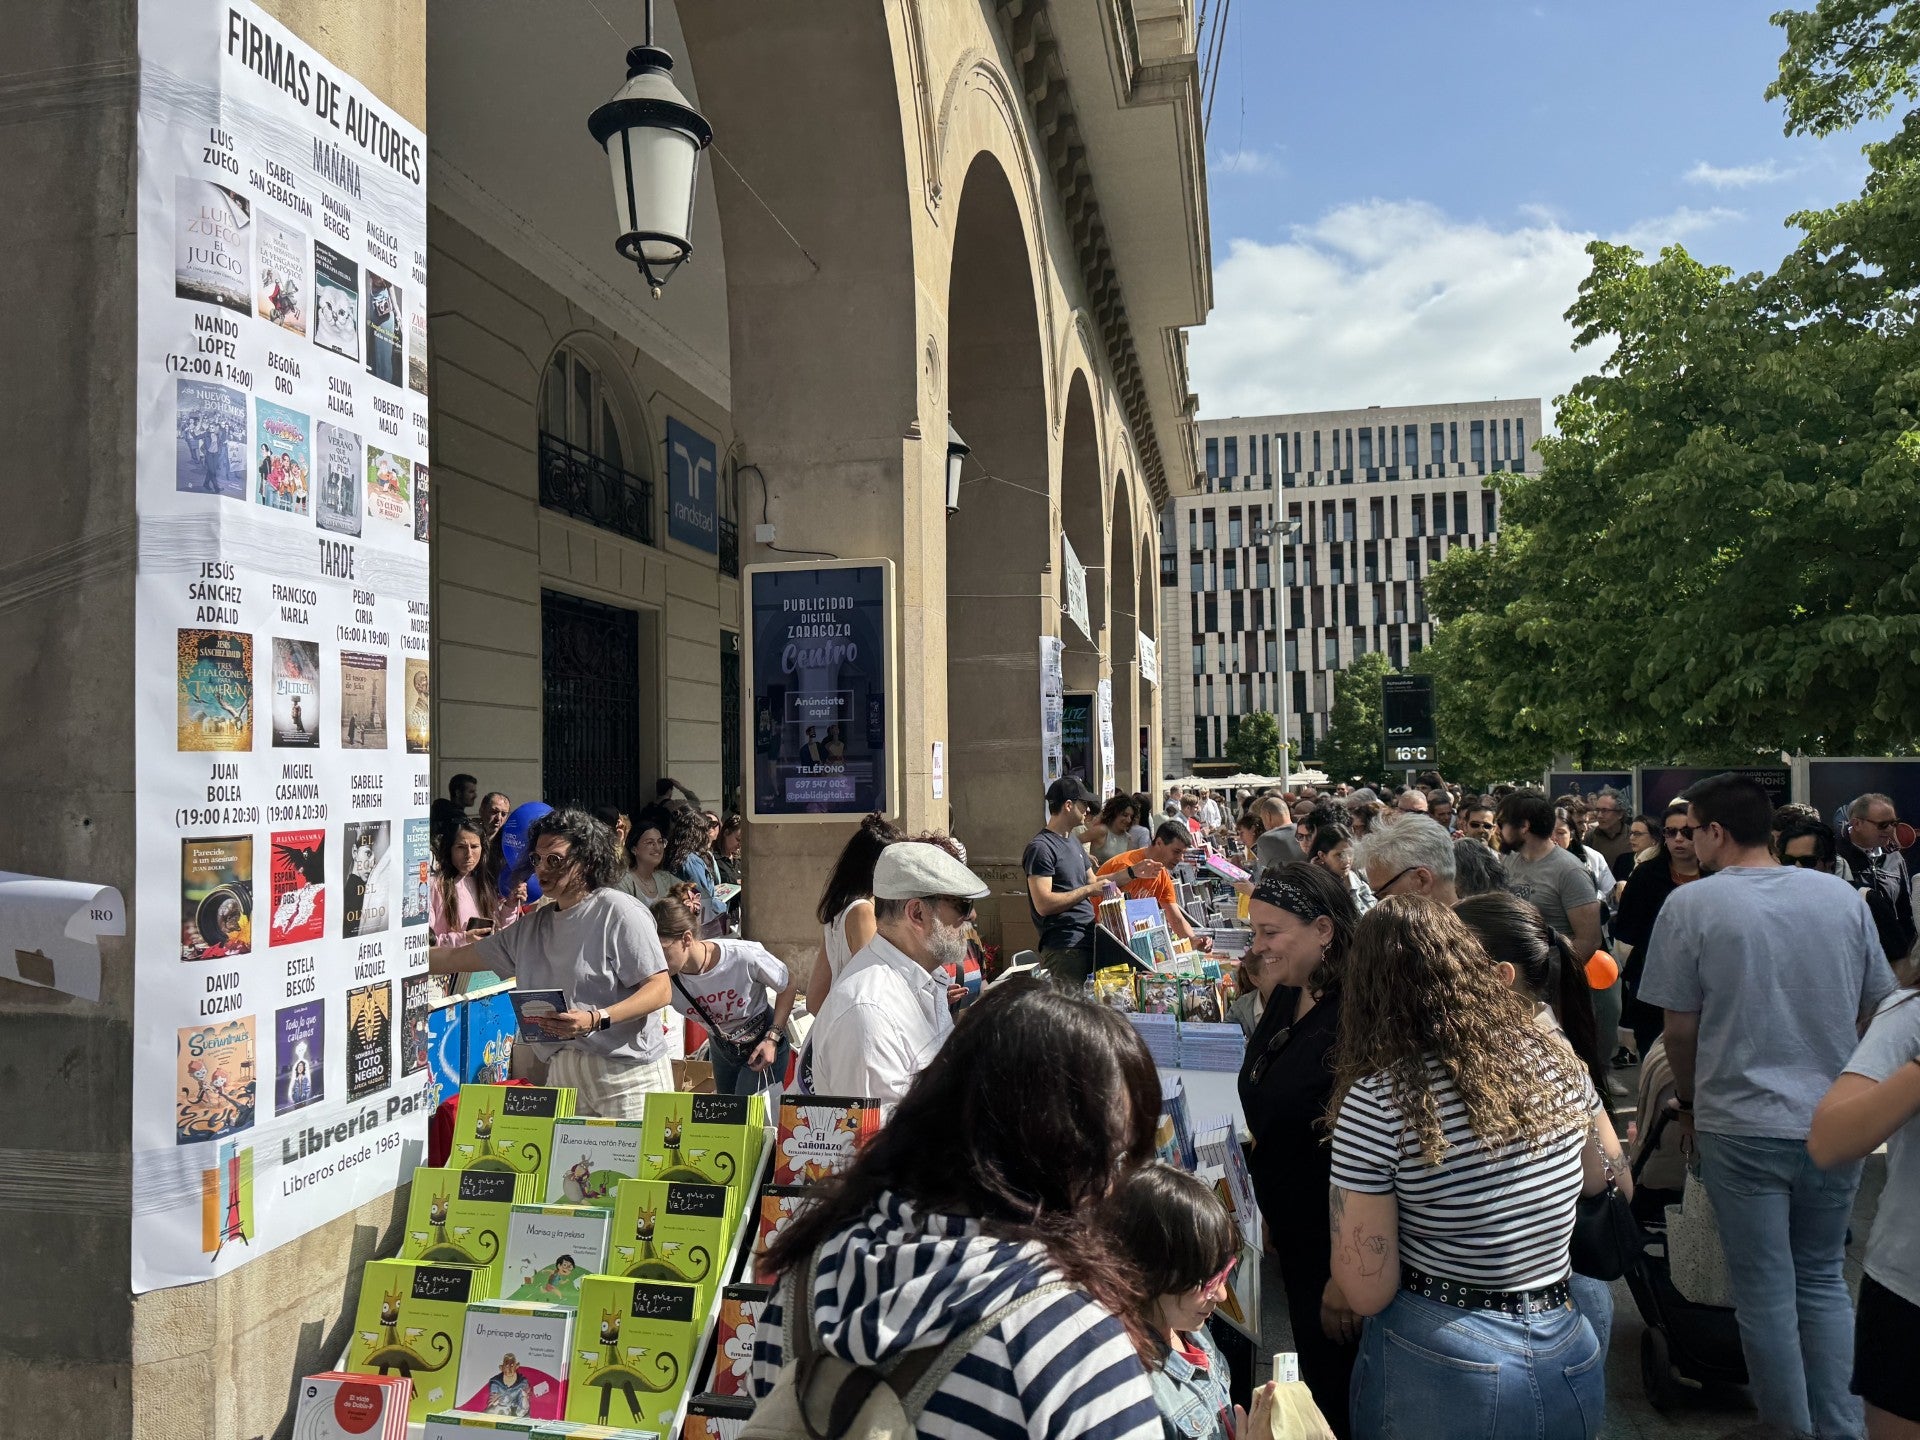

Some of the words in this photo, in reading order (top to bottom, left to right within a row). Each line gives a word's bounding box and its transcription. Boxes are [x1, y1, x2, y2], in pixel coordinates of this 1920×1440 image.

[228, 7, 311, 106] FIRMAS
[315, 71, 341, 129] DE
[345, 95, 420, 185] AUTORES
[210, 128, 234, 152] LUIS
[203, 147, 239, 175] ZUECO
[313, 137, 361, 200] MAÑANA
[266, 159, 295, 189] ISABEL
[249, 169, 265, 193] SAN
[266, 179, 312, 218] SEBASTIÁN
[321, 192, 351, 223] JOAQUÍN
[201, 205, 234, 228] LUIS
[187, 219, 240, 247] ZUECO
[323, 212, 350, 240] BERGES
[366, 220, 398, 252] ANGÉLICA
[214, 240, 225, 252] EL
[367, 239, 397, 268] MORALES
[187, 246, 242, 275] JUICIO
[194, 313, 239, 338] NANDO
[199, 335, 236, 360] LÓPEZ
[165, 353, 211, 375] (12:00
[214, 361, 223, 377] A
[226, 364, 253, 391] 14:00)
[268, 351, 301, 379] BEGOÑA
[275, 376, 293, 395] ORO
[328, 376, 352, 398] SILVIA
[196, 390, 231, 404] NUEVOS
[327, 395, 354, 418] ALIAGA
[373, 396, 404, 421] ROBERTO
[379, 417, 398, 436] MALO
[328, 435, 354, 452] VERANO
[329, 454, 352, 466] NUNCA
[674, 501, 713, 533] randstad
[318, 538, 355, 580] TARDE
[199, 561, 235, 581] JESÚS
[188, 581, 242, 604] SÁNCHEZ
[272, 583, 317, 606] FRANCISCO
[353, 588, 375, 607] PEDRO
[783, 597, 854, 612] PUBLICIDAD
[196, 606, 239, 625] ADALID
[281, 606, 309, 625] NARLA
[355, 608, 374, 626] CIRIA
[801, 612, 836, 623] DIGITAL
[336, 624, 361, 642] (16:00
[361, 630, 367, 642] A
[368, 630, 390, 648] 19:00)
[787, 623, 851, 639] ZARAGOZA
[400, 635, 420, 651] (16:00
[420, 638, 426, 651] A
[733, 635, 739, 651] S
[199, 648, 225, 658] SÁNCHEZ
[781, 640, 858, 674] Centro
[198, 668, 244, 679] HALCONES
[216, 662, 232, 670] TRES
[795, 696, 845, 706] Anúnciate
[809, 707, 831, 718] aquí
[1395, 747, 1427, 760] 16°C
[210, 763, 239, 780] JUAN
[282, 763, 313, 780] MIGUEL
[796, 763, 845, 774] TELÉFONO
[351, 775, 383, 790] ISABELLE
[812, 780, 827, 788] 547
[207, 786, 242, 802] BOLEA
[275, 784, 319, 801] CASANOVA
[351, 793, 382, 808] PARRISH
[413, 792, 425, 805] DEL
[175, 808, 220, 828] (19:00
[222, 808, 230, 824] A
[232, 806, 260, 824] 20:30)
[266, 805, 293, 825] (19:00
[294, 804, 301, 820] A
[302, 803, 328, 822] 20:30)
[361, 835, 374, 846] EL
[193, 849, 225, 857] Parecido
[211, 855, 239, 864] asesinato
[191, 865, 207, 873] JUAN
[274, 882, 298, 894] PARTIDA
[357, 884, 377, 896] DEL
[274, 895, 282, 906] EN
[282, 894, 295, 905] DOS
[346, 906, 386, 922] OLVIDO
[357, 941, 383, 961] ÁFRICA
[287, 956, 315, 977] ESTELA
[354, 960, 386, 981] VÁZQUEZ
[206, 972, 240, 993] DAVID
[286, 974, 316, 998] BESCÓS
[200, 993, 242, 1016] LOZANO
[285, 1019, 299, 1030] Todo
[299, 1016, 305, 1028] lo
[305, 1015, 317, 1029] que
[287, 1026, 314, 1043] callamos
[354, 1049, 374, 1060] SOMBRA
[358, 1055, 381, 1071] LOTO
[354, 1065, 384, 1084] NEGRO
[505, 1102, 537, 1112] Valero
[521, 1095, 548, 1103] quiero
[710, 1101, 738, 1111] quiero
[692, 1109, 728, 1121] Valero
[282, 1107, 379, 1165] Librería
[816, 1132, 825, 1141] El
[797, 1141, 842, 1151] cañonazo
[283, 1160, 335, 1197] Libreros
[337, 1146, 371, 1172] desde
[375, 1132, 400, 1155] 1963
[461, 1186, 494, 1196] Valero
[478, 1178, 505, 1187] quiero
[686, 1192, 715, 1201] quiero
[669, 1200, 704, 1211] Valero
[526, 1223, 551, 1236] Marisa
[551, 1231, 556, 1239] y
[556, 1229, 563, 1237] la
[563, 1230, 585, 1239] pelusa
[433, 1275, 461, 1285] quiero
[414, 1283, 449, 1295] Valero
[652, 1293, 683, 1304] quiero
[634, 1302, 671, 1313] Valero
[476, 1324, 486, 1335] Un
[486, 1328, 514, 1338] príncipe
[514, 1330, 530, 1341] algo
[530, 1332, 552, 1341] rarito
